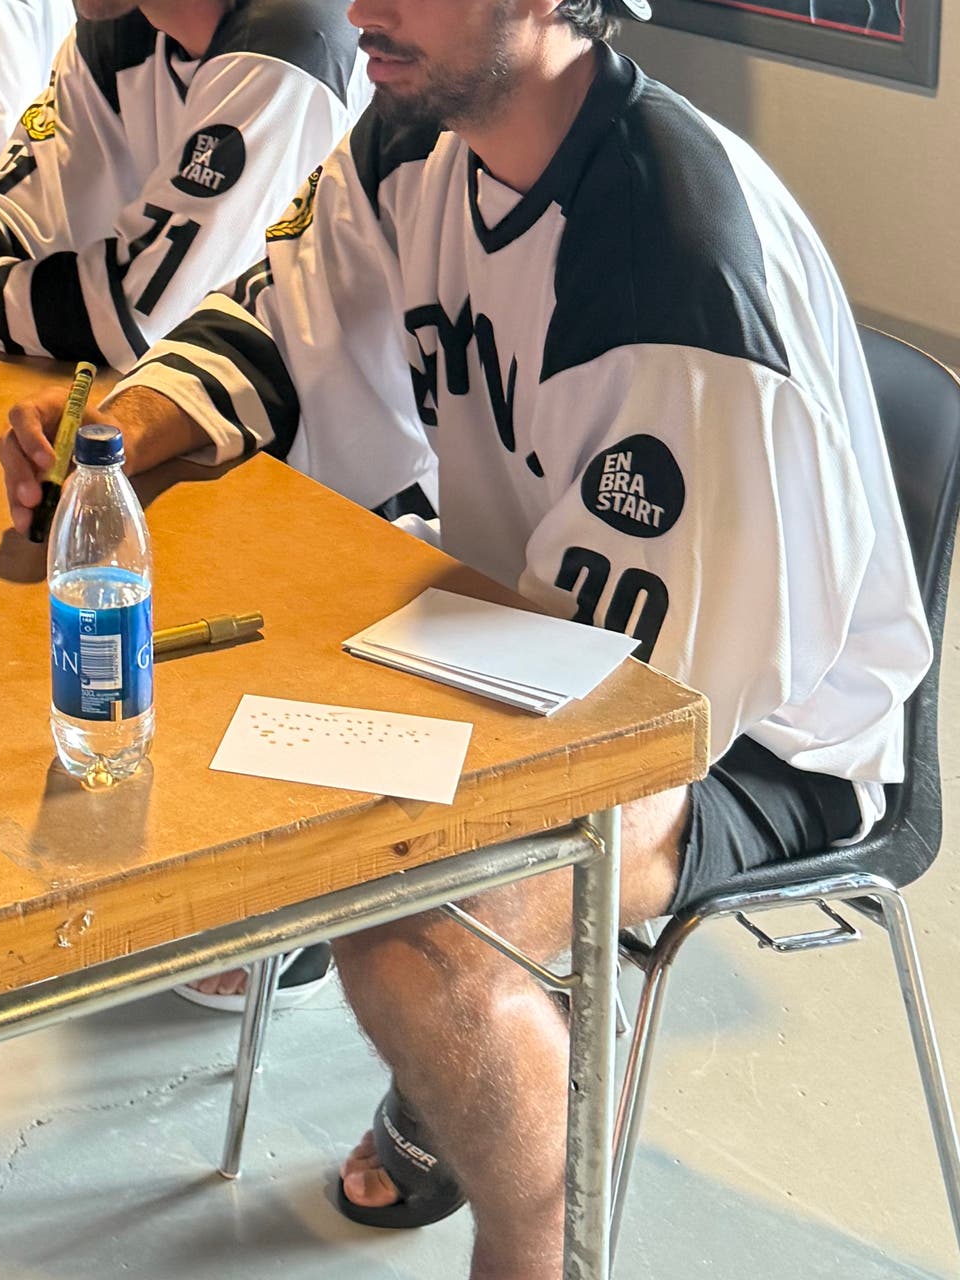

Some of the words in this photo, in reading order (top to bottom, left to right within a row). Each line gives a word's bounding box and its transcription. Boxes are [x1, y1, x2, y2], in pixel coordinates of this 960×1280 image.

[181, 163, 226, 191] ART
[603, 451, 632, 473] EN
[598, 472, 646, 499] BRA
[595, 492, 666, 528] START
